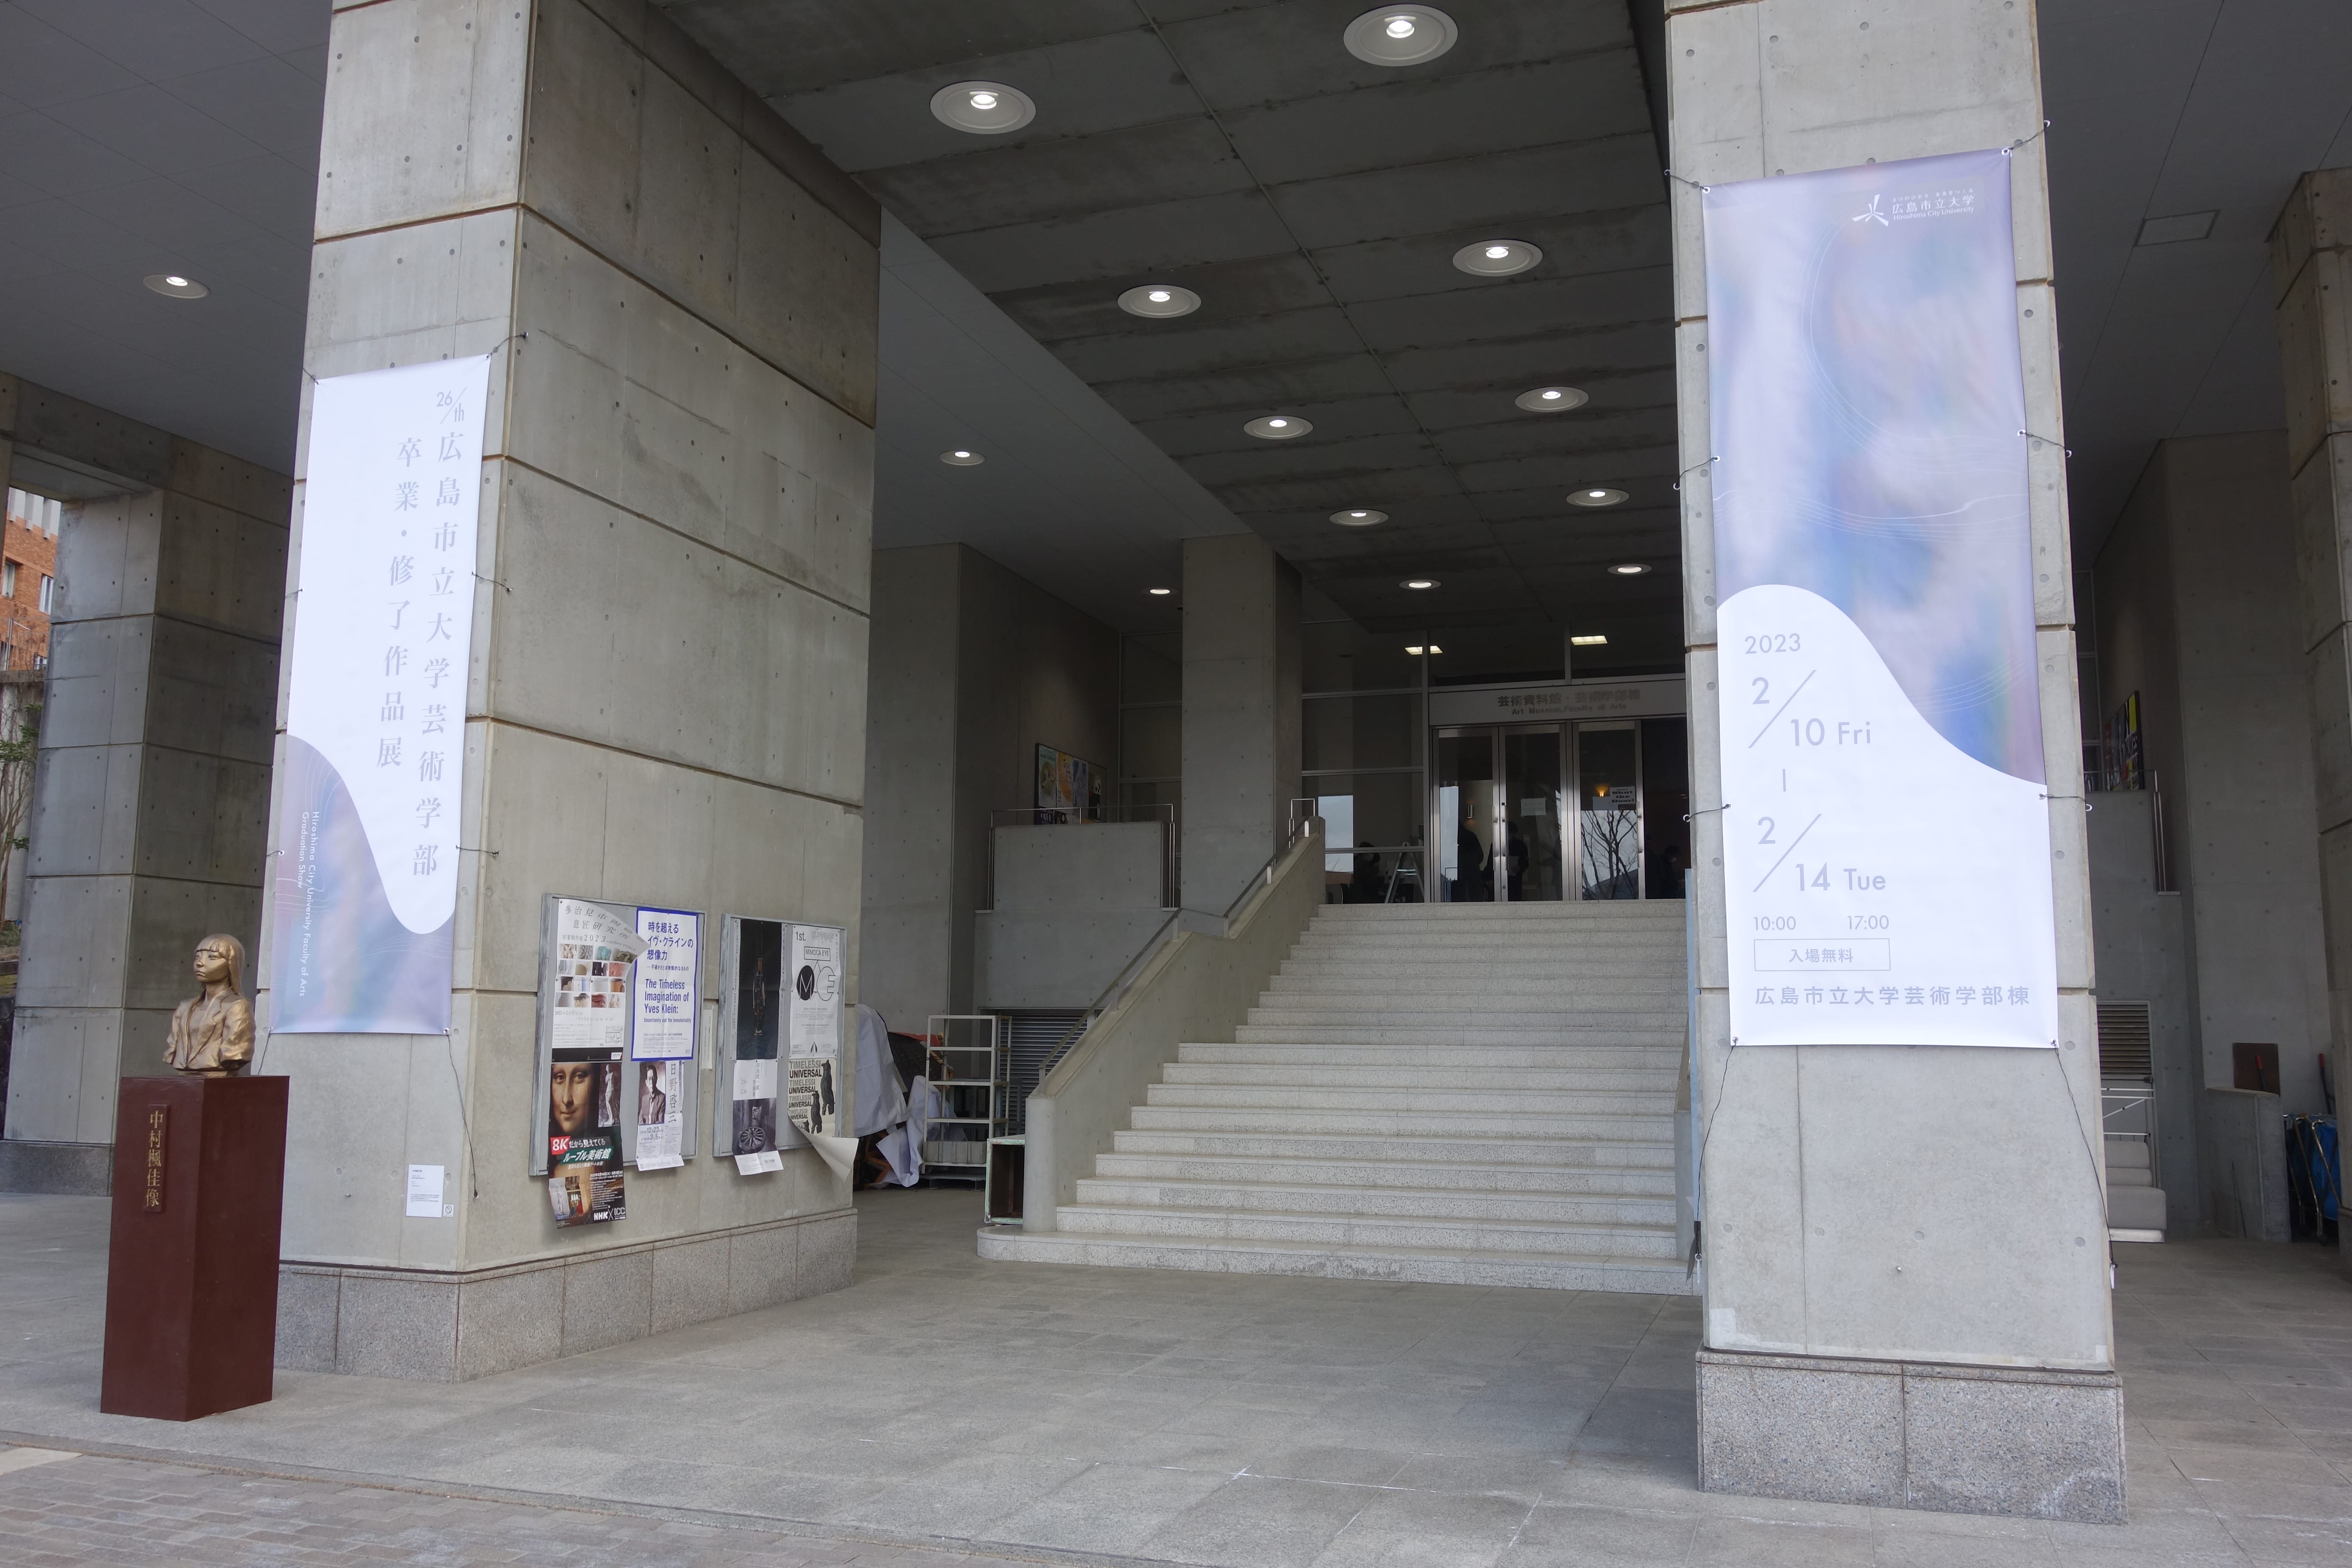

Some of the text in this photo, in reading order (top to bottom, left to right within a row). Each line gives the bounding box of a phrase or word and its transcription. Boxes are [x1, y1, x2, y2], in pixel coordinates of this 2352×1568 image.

[1892, 194, 1974, 214] 広島市立大学
[1893, 212, 1926, 220] Hiroshima
[1941, 206, 1974, 215] University
[376, 438, 421, 768] 卒業・修了作品展
[1744, 633, 1801, 654] 2023
[413, 432, 464, 876] 広島市立大学芸術学部
[1838, 721, 1871, 745] Fri
[309, 812, 319, 860] Hiroshima
[297, 812, 309, 888] Graduation Show
[306, 865, 315, 884] City
[1843, 868, 1886, 891] Tue
[303, 888, 314, 930] University
[648, 921, 679, 934] 時を超える
[1754, 915, 1889, 931] 10:00 17:00
[648, 935, 693, 948] イヴ・クラインの
[796, 931, 806, 941] 1st.
[300, 933, 311, 964] Faculty
[647, 949, 668, 961] 想像力
[1789, 948, 1853, 963] 入場無料
[301, 967, 309, 976] of
[645, 978, 685, 989] The Timeless
[645, 991, 689, 1003] Imagination of
[1755, 986, 2030, 1006] 広島市立大学芸術学部棟
[644, 1003, 678, 1014] Yves Klein:
[789, 1069, 822, 1078] UNIVERSAL
[668, 1063, 677, 1123] 日野啓三
[789, 1086, 816, 1094] UNIVERSAL
[552, 1138, 569, 1151] 8K
[563, 1148, 612, 1162] ルーブル美術館
[594, 1211, 608, 1221] NHK
